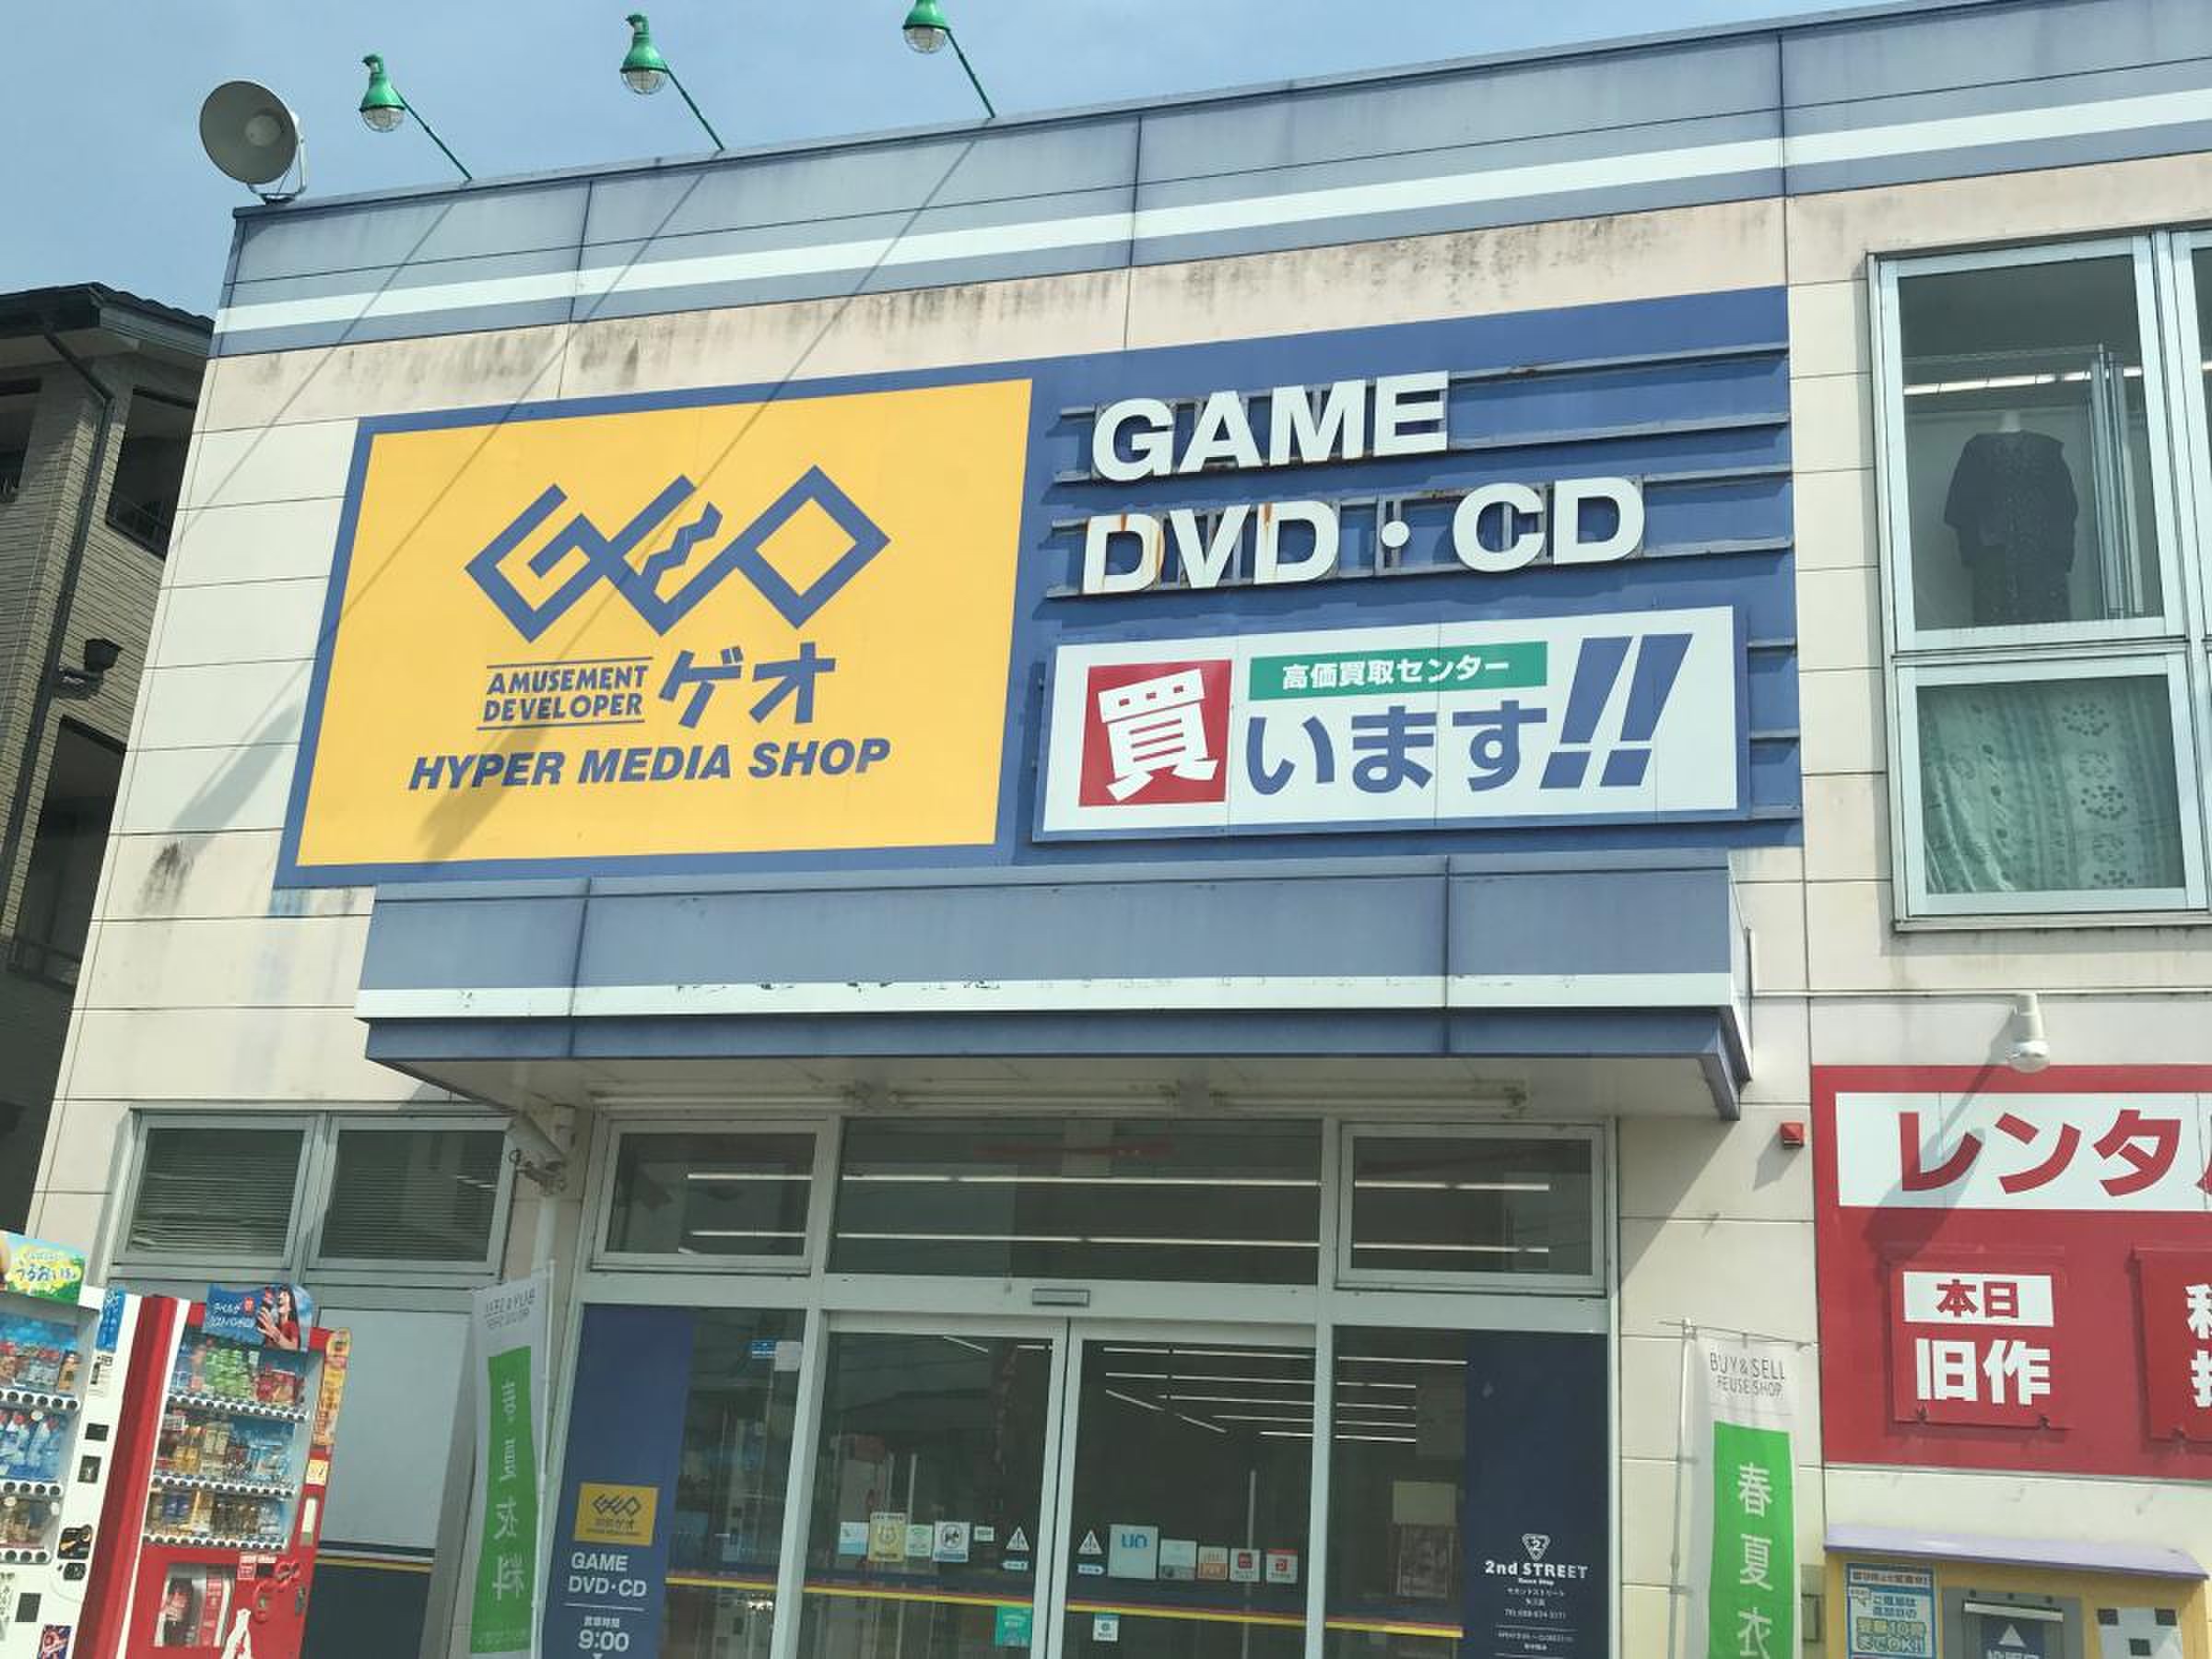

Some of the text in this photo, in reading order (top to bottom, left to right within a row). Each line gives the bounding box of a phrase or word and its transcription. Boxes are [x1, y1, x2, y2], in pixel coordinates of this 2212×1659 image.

[1091, 371, 1449, 482] GAME
[486, 665, 649, 695] AMUSEMENT
[658, 641, 837, 728] ゲオ
[1281, 656, 1510, 692] 高価買取センター
[483, 693, 643, 723] DEVELOPER
[408, 738, 891, 791] HYPER MEDIA SHOP
[1936, 1278, 2020, 1318] 本日
[1915, 1338, 2051, 1406] 旧作
[571, 1552, 629, 1571] GAME
[1485, 1559, 1588, 1579] 2nd STREET
[577, 1630, 629, 1653] 9:00
